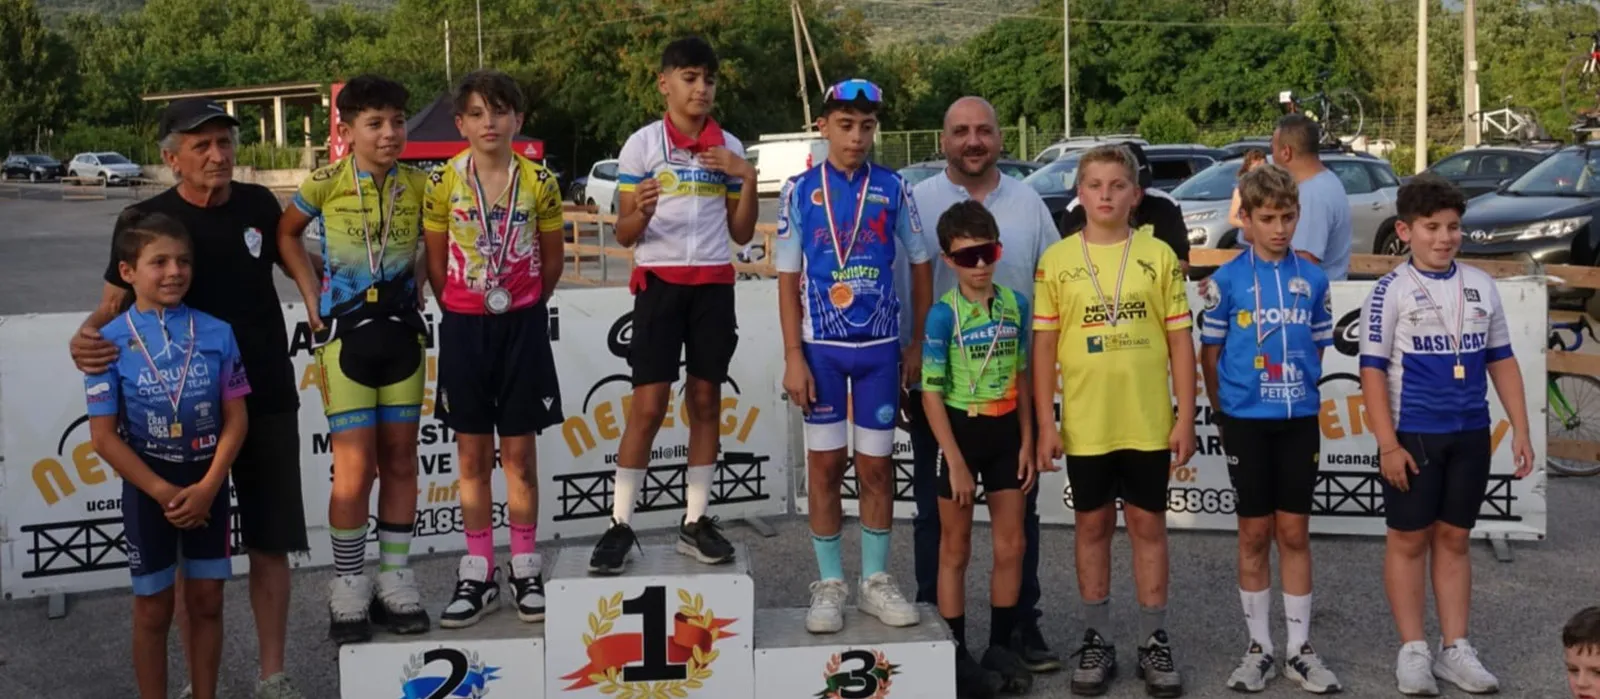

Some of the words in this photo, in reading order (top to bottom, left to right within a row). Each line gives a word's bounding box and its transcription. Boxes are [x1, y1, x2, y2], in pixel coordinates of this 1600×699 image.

[622, 586, 687, 683] 1
[420, 648, 469, 699] 2
[840, 650, 878, 698] 3
